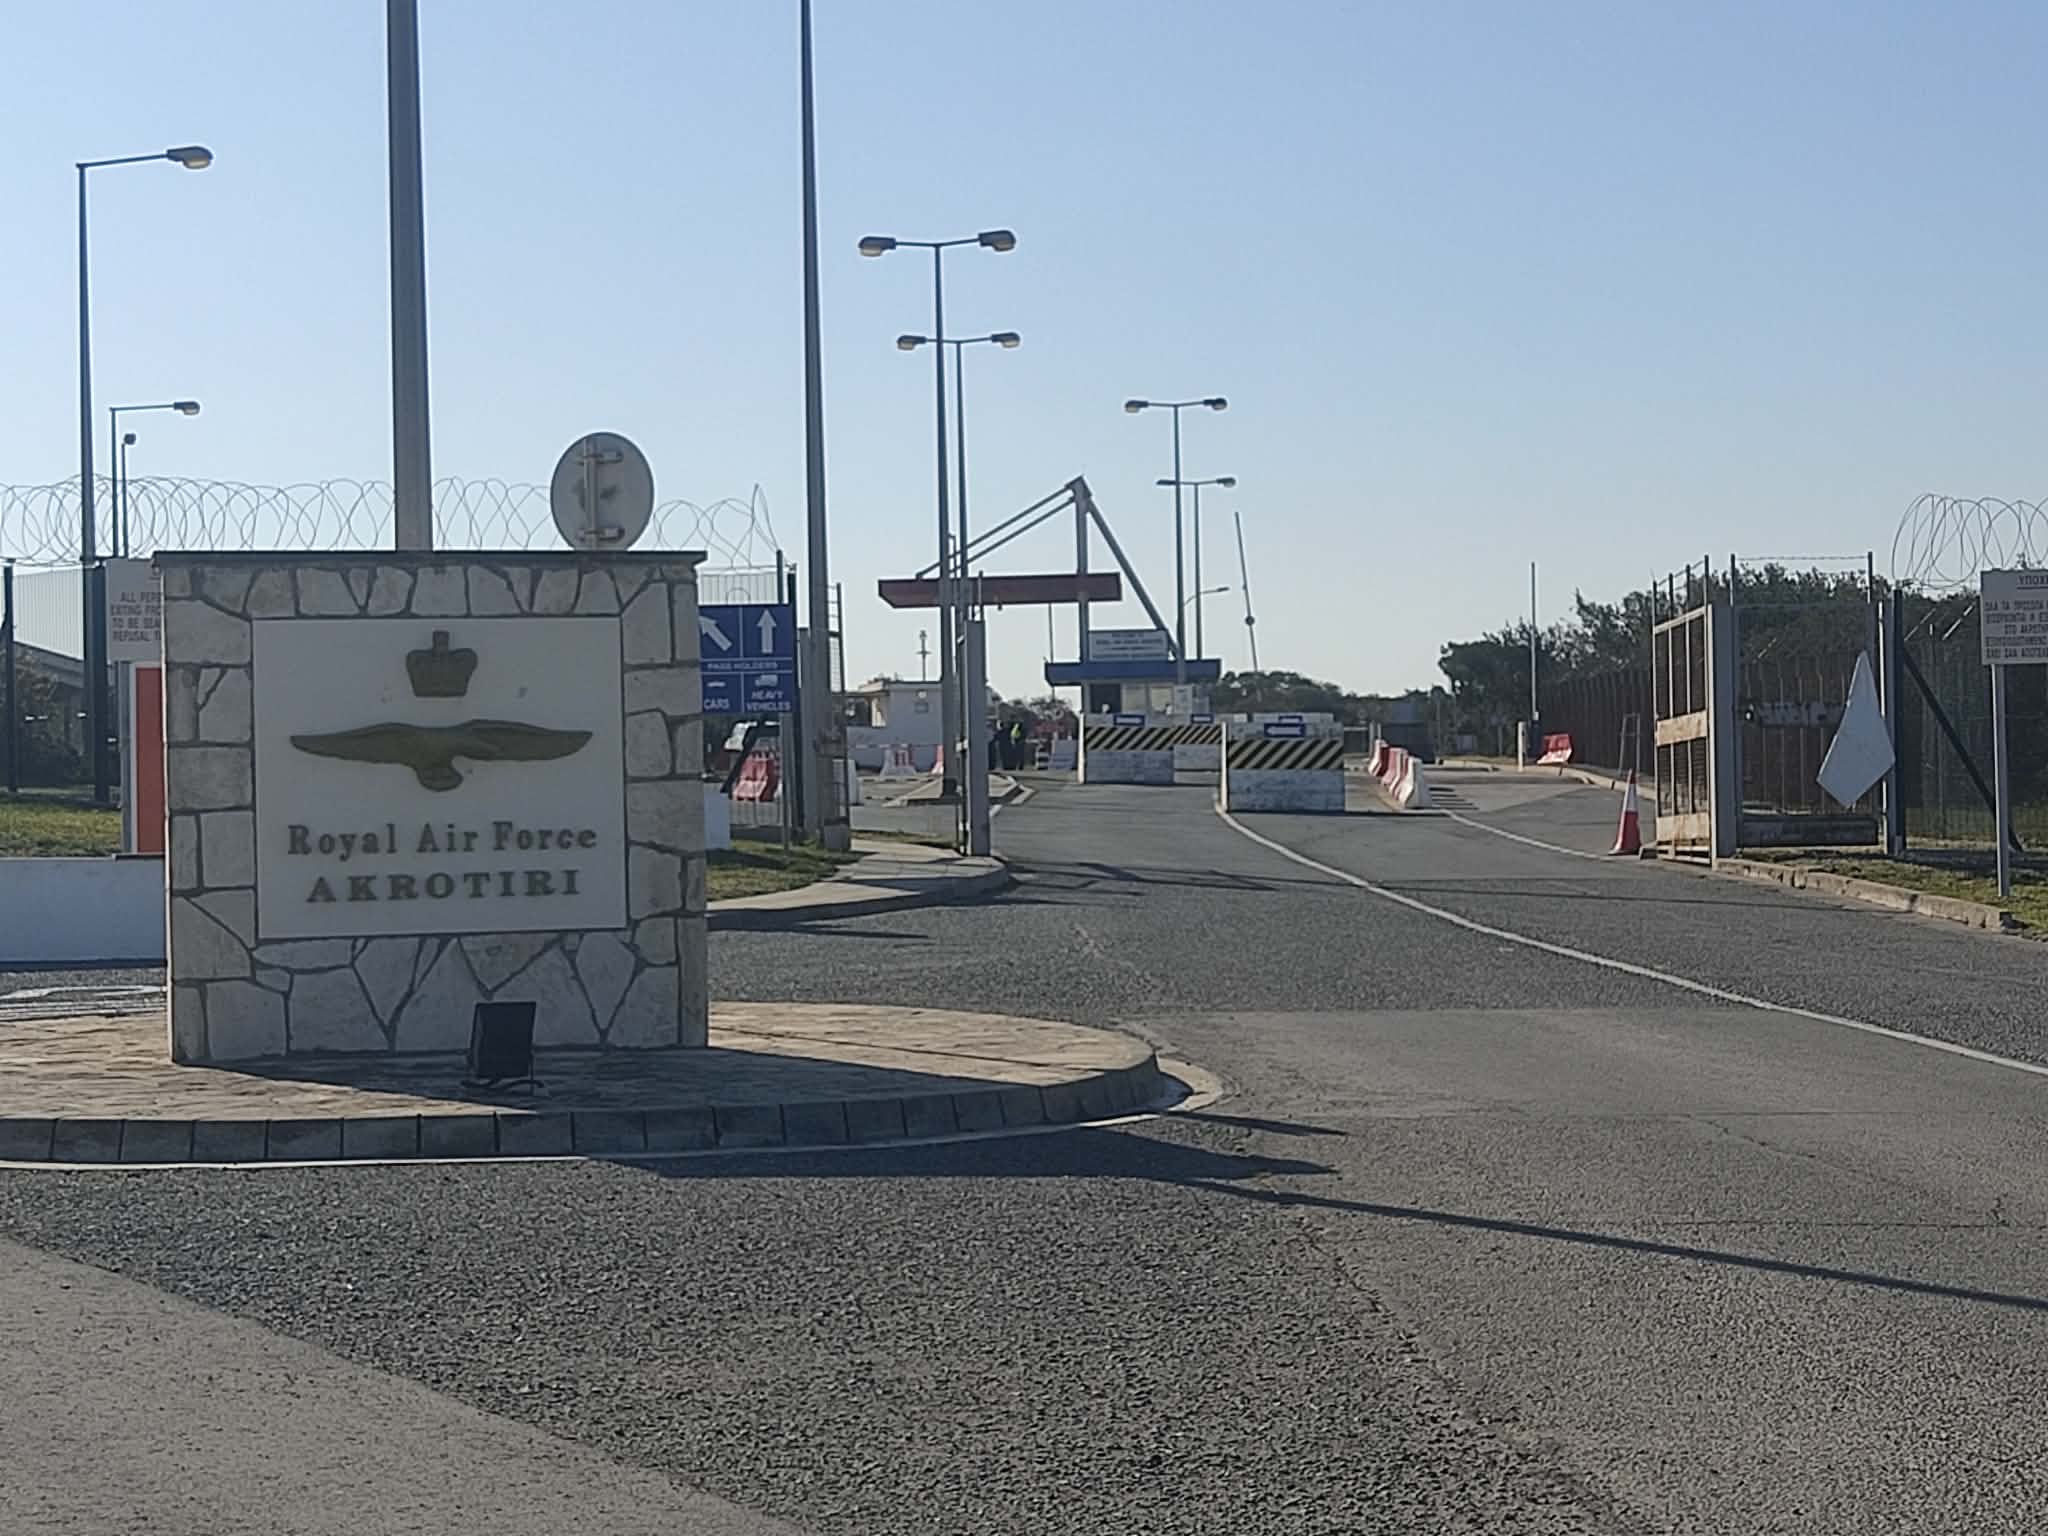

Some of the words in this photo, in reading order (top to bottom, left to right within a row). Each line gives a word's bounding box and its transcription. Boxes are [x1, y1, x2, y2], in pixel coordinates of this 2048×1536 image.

[751, 690, 784, 700] HEAVY
[703, 698, 730, 710] CARS
[746, 701, 791, 711] VEHICLES
[287, 823, 397, 861] Royal
[416, 822, 478, 852] Air
[492, 820, 597, 851] Force
[306, 869, 580, 903] AKROTIRI
